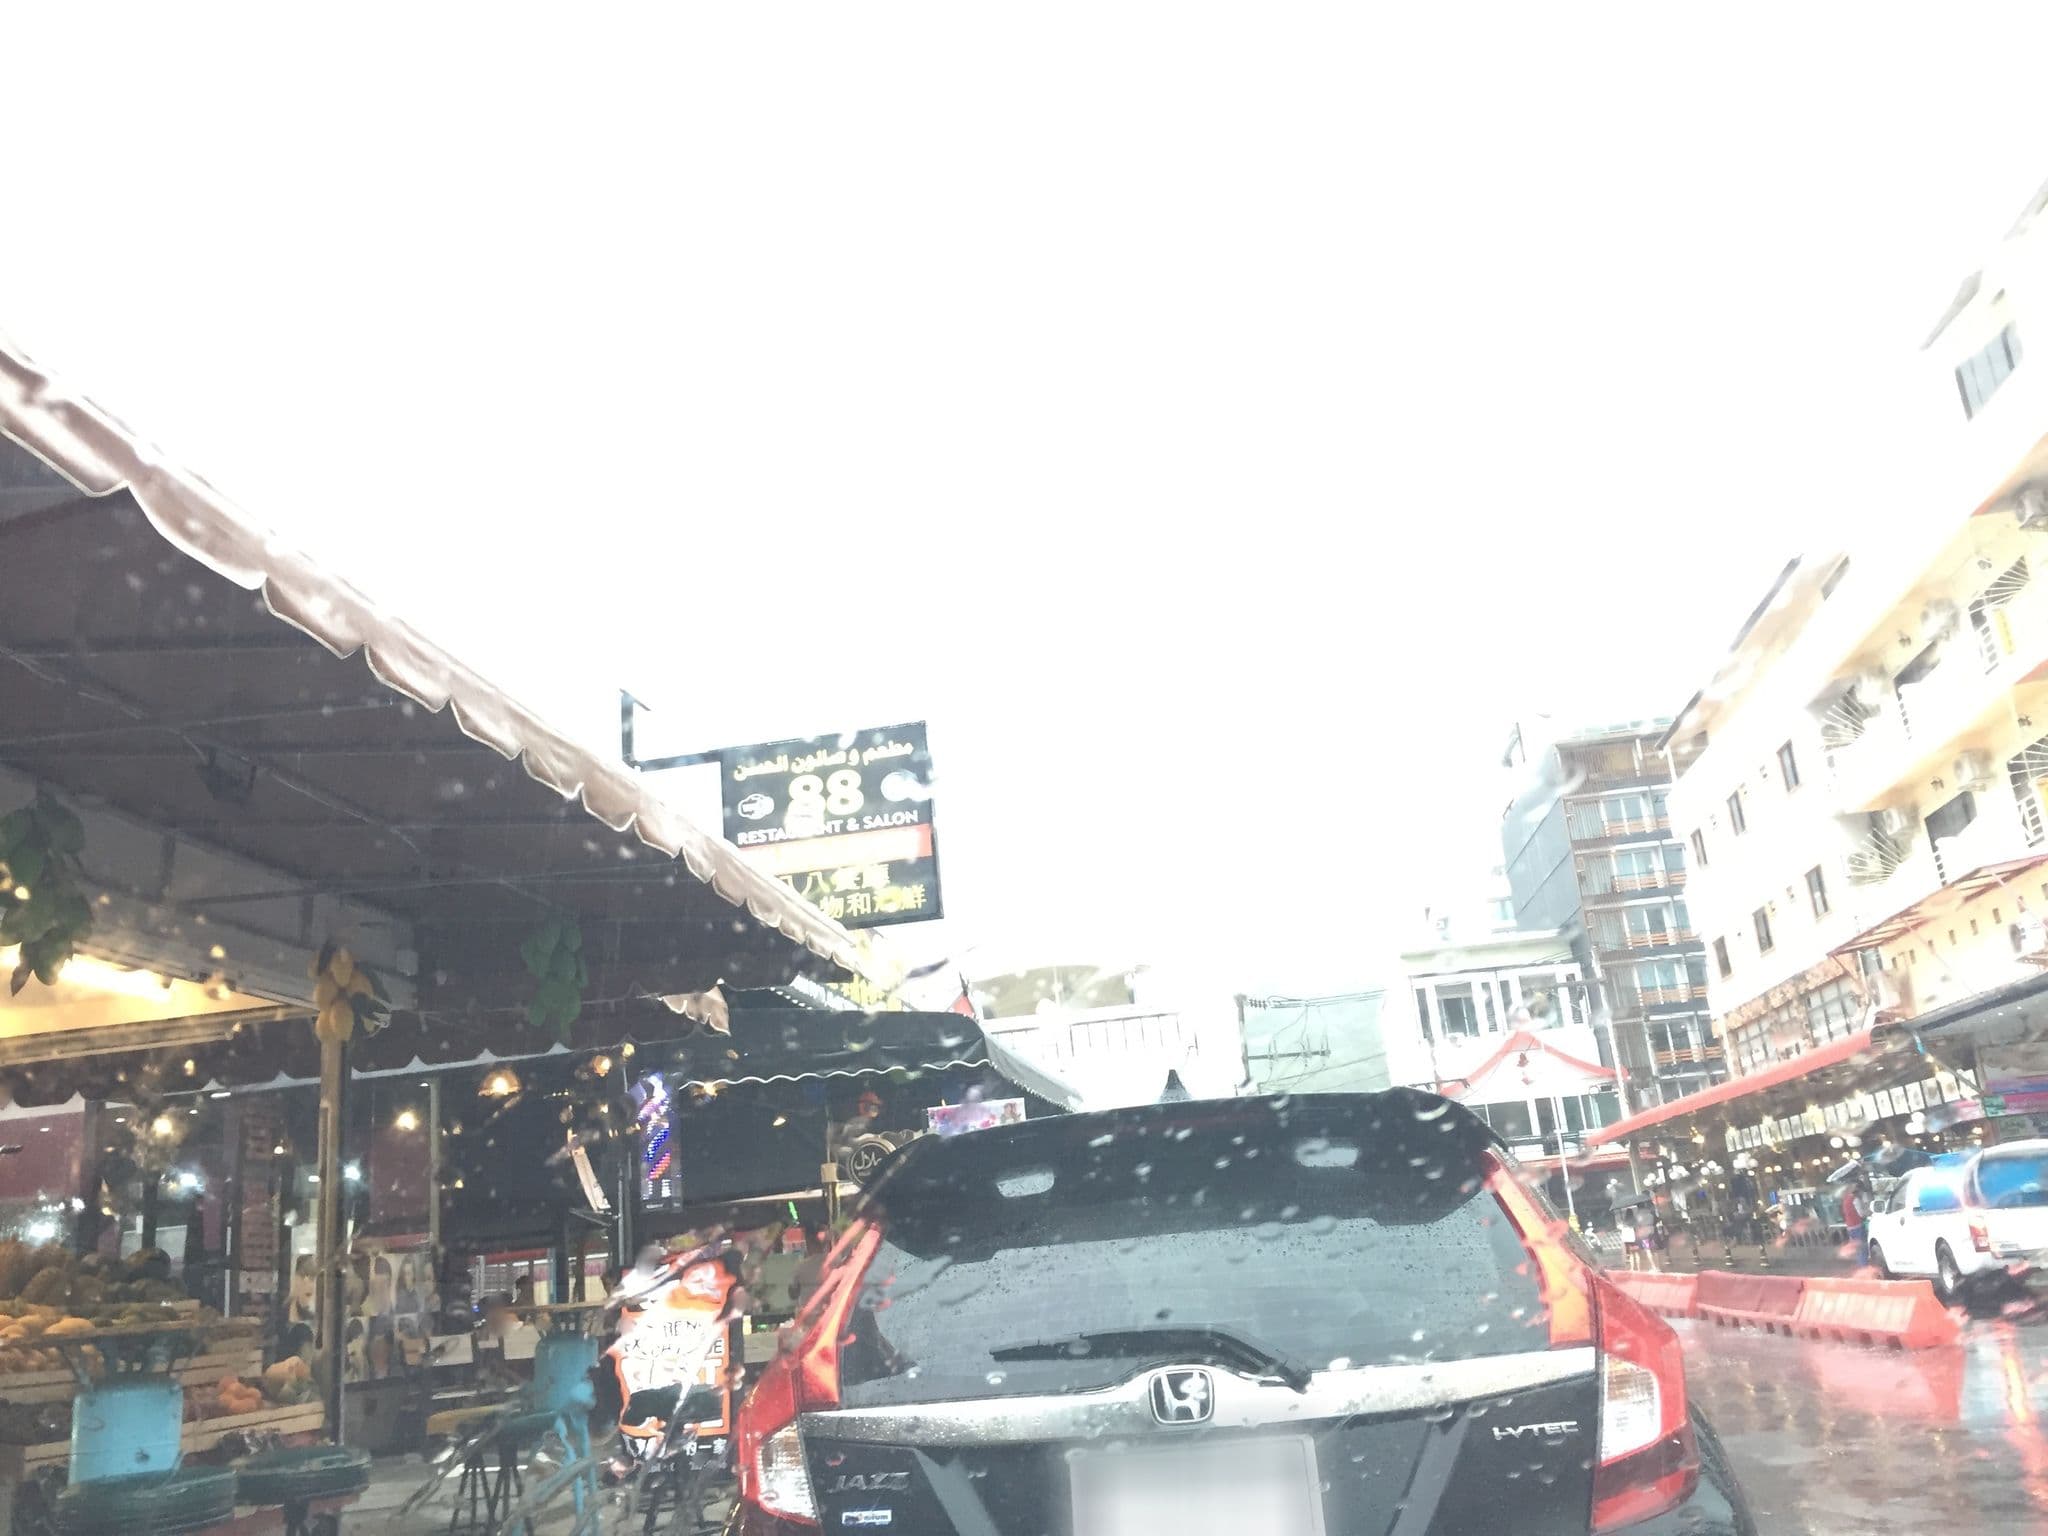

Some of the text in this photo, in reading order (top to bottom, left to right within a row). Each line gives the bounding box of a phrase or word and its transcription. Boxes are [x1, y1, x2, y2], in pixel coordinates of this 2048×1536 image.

[787, 769, 865, 820] 88
[737, 810, 920, 846] RESTANT & SALON
[826, 1471, 911, 1493] JAZZ
